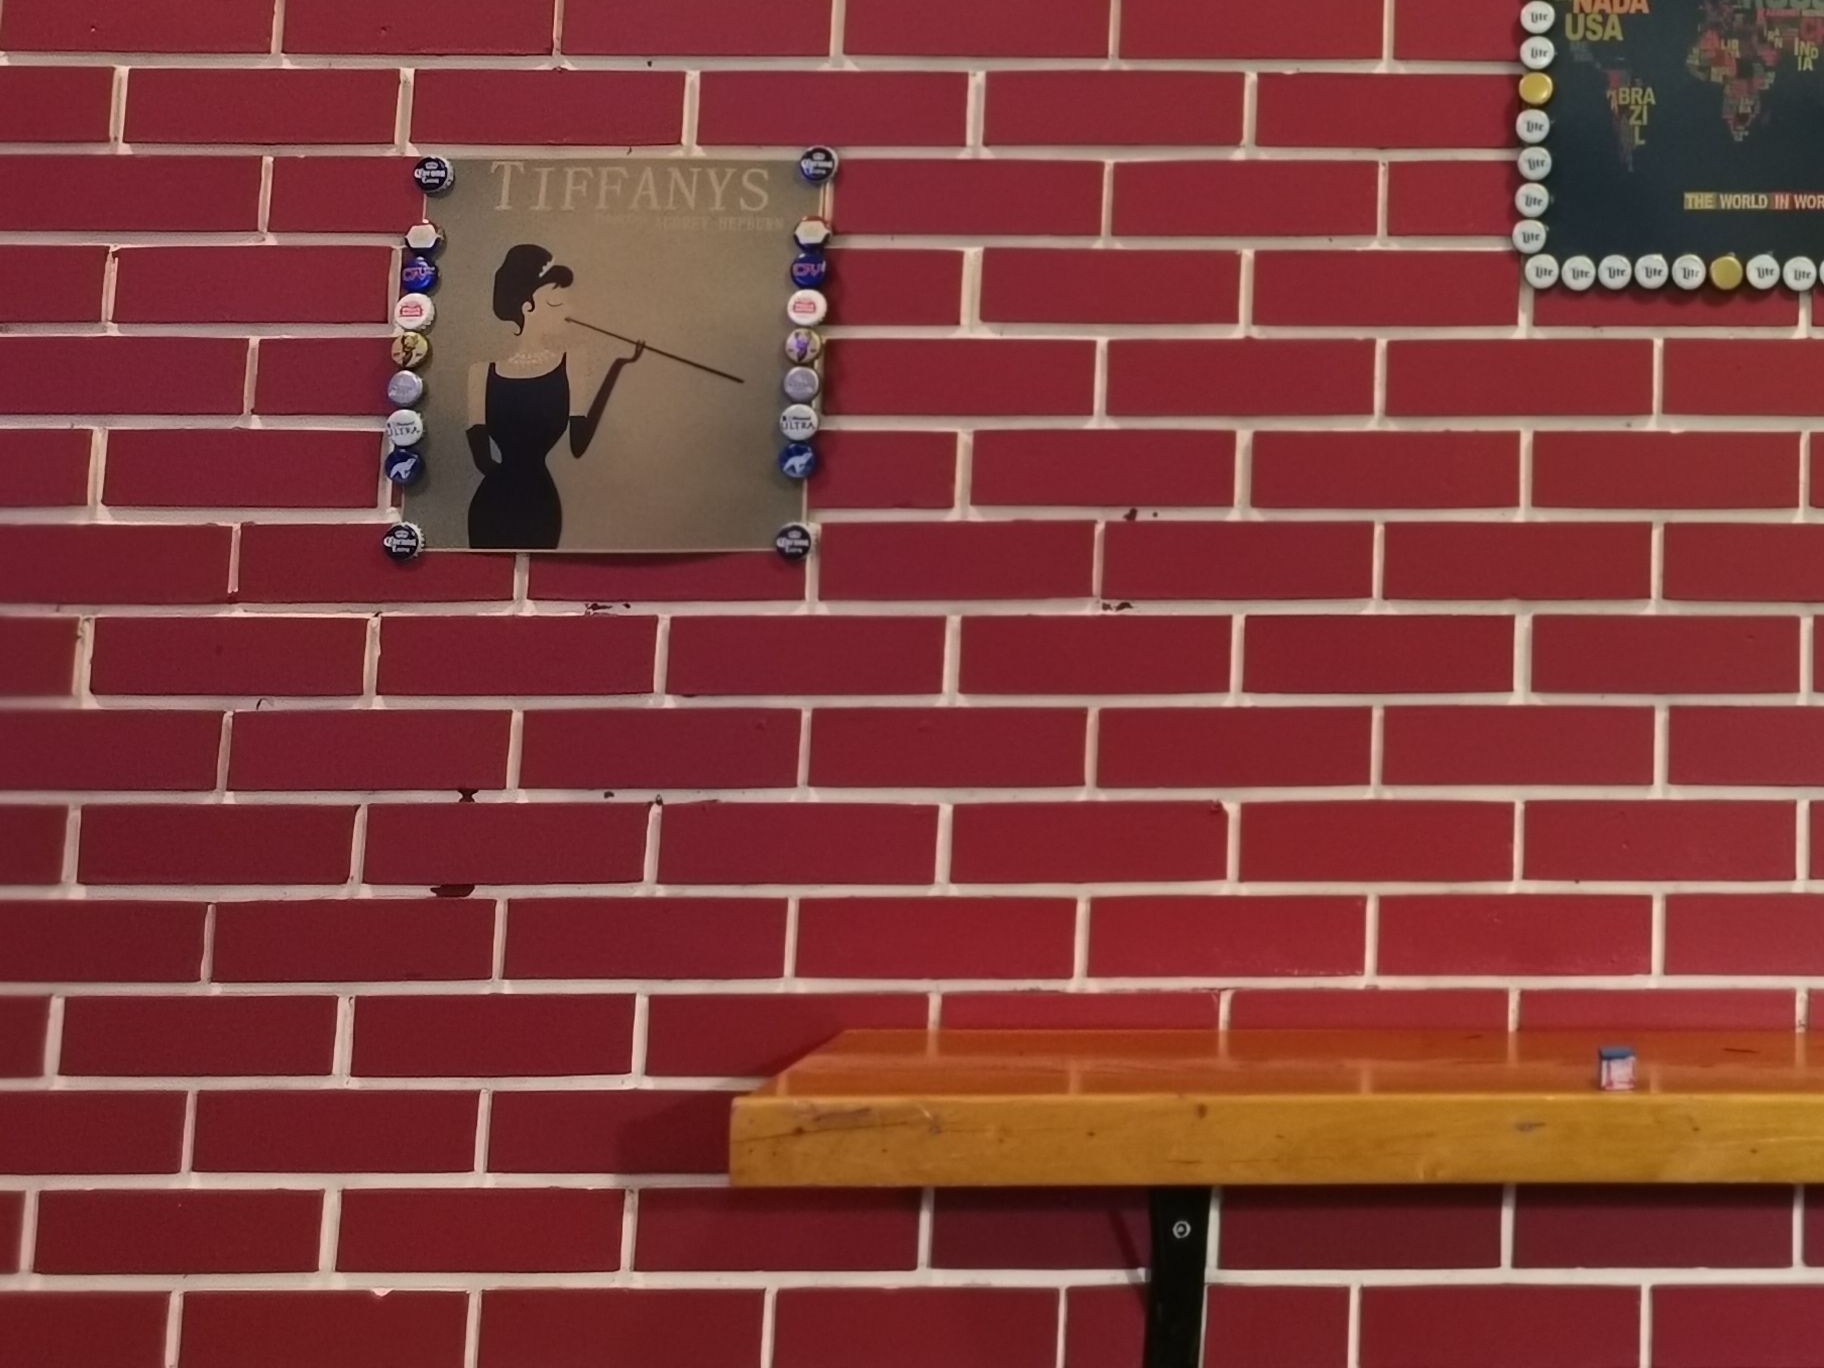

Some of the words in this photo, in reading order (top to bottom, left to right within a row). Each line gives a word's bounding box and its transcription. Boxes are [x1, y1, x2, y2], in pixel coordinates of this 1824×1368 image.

[1564, 13, 1624, 42] USA
[490, 160, 770, 212] TIFFANYS
[1686, 194, 1714, 209] THE
[1719, 194, 1768, 210] WORLD
[1774, 194, 1790, 210] IN
